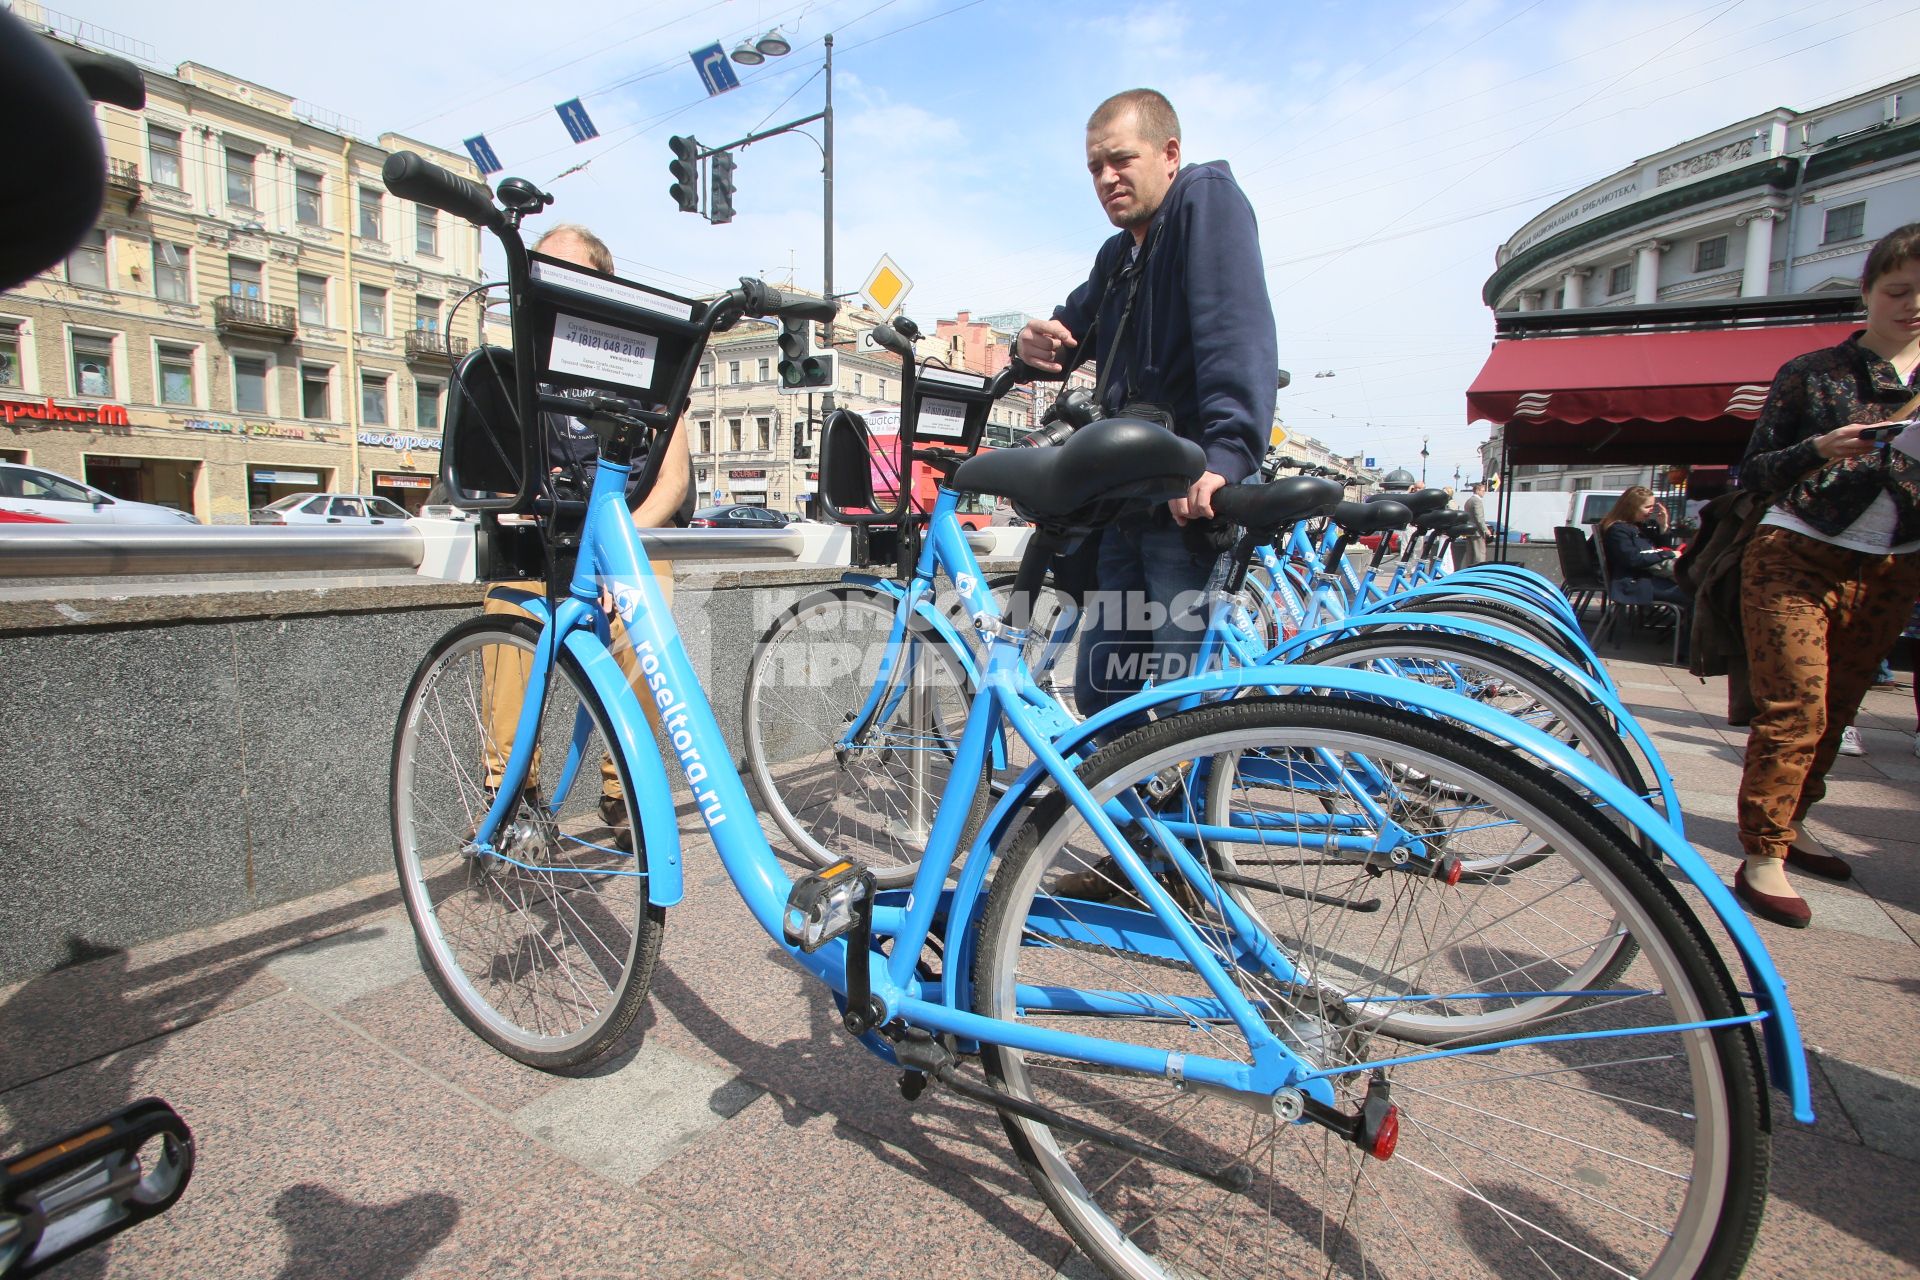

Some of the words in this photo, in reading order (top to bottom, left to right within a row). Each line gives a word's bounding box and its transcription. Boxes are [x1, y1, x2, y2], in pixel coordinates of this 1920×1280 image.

[1582, 183, 1637, 212] БИБЛИОТЕКА
[565, 331, 577, 343] +7
[578, 333, 602, 351] (812)
[603, 339, 621, 353] 648
[622, 344, 632, 355] 21
[634, 347, 645, 359] 00
[635, 640, 727, 828] roseltorg.ru
